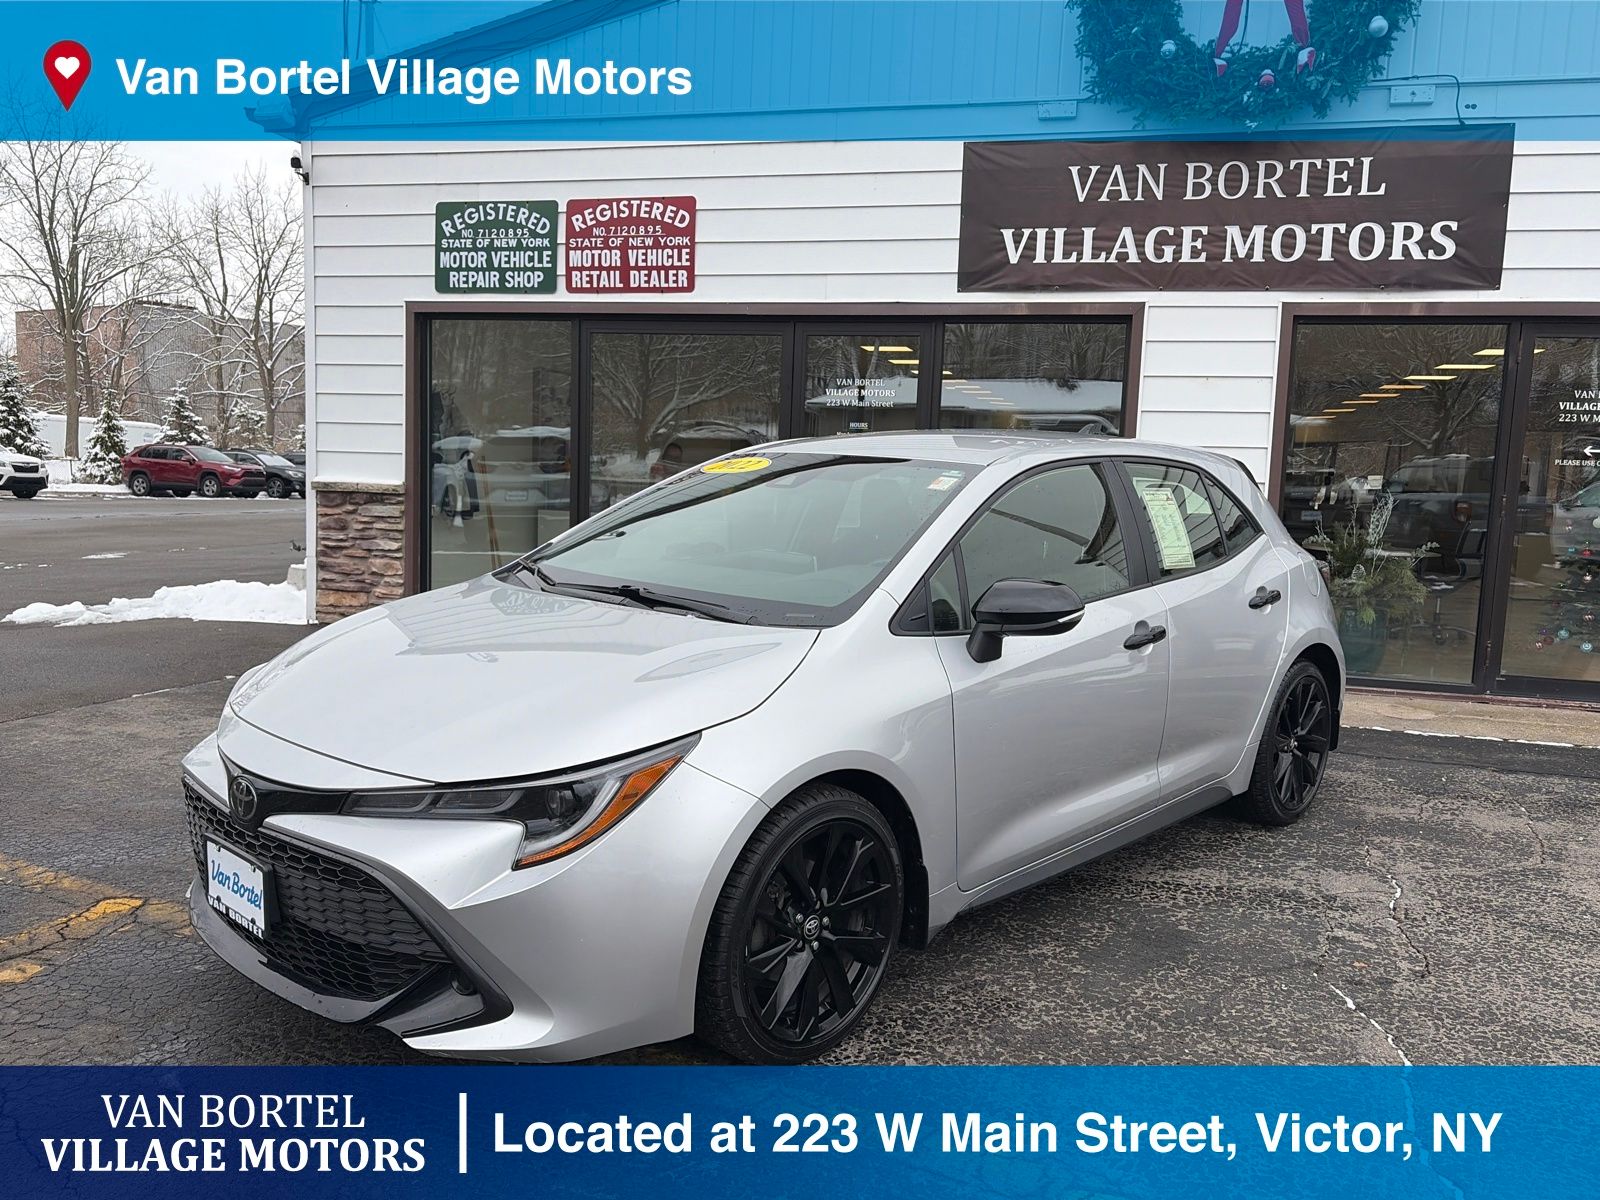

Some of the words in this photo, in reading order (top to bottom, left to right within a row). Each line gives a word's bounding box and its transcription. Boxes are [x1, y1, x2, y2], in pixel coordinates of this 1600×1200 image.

[1069, 163, 1168, 202] VAN
[1183, 156, 1386, 201] BORTEL
[441, 203, 550, 237] REGISTERED
[571, 200, 690, 232] REGISTERED
[461, 229, 475, 238] NO.
[478, 228, 530, 238] 7120895
[593, 227, 607, 236] NO.
[609, 226, 662, 236] 7120895
[441, 239, 473, 248] STATE
[476, 239, 491, 247] OF
[493, 239, 518, 247] NEW
[521, 238, 551, 248] YORK
[569, 238, 604, 248] STATE
[608, 237, 625, 247] OF
[628, 237, 654, 247] NEW
[658, 236, 691, 246] YORK
[1000, 225, 1209, 264] VILLAGE
[1222, 220, 1459, 263] MOTORS
[440, 252, 487, 269] MOTOR
[492, 251, 552, 268] VEHICLE
[569, 250, 621, 267] MOTOR
[628, 249, 691, 267] VEHICLE
[450, 272, 500, 288] REPAIR
[505, 271, 544, 288] SHOP
[571, 271, 624, 288] RETAIL
[629, 270, 688, 288] DEALER
[836, 378, 853, 387] VAN
[854, 378, 885, 387] BORTEL
[825, 388, 859, 397] VILLAGE
[861, 388, 896, 397] MOTORS
[1574, 390, 1596, 399] VAN
[826, 399, 841, 407] 223
[842, 399, 851, 407] W
[852, 399, 870, 407] Main
[871, 399, 894, 408] Street
[1558, 413, 1578, 422] 223
[1580, 413, 1591, 422] W
[1581, 459, 1595, 467] USE
[208, 895, 226, 914] VAN
[229, 907, 263, 939] BORTEL
